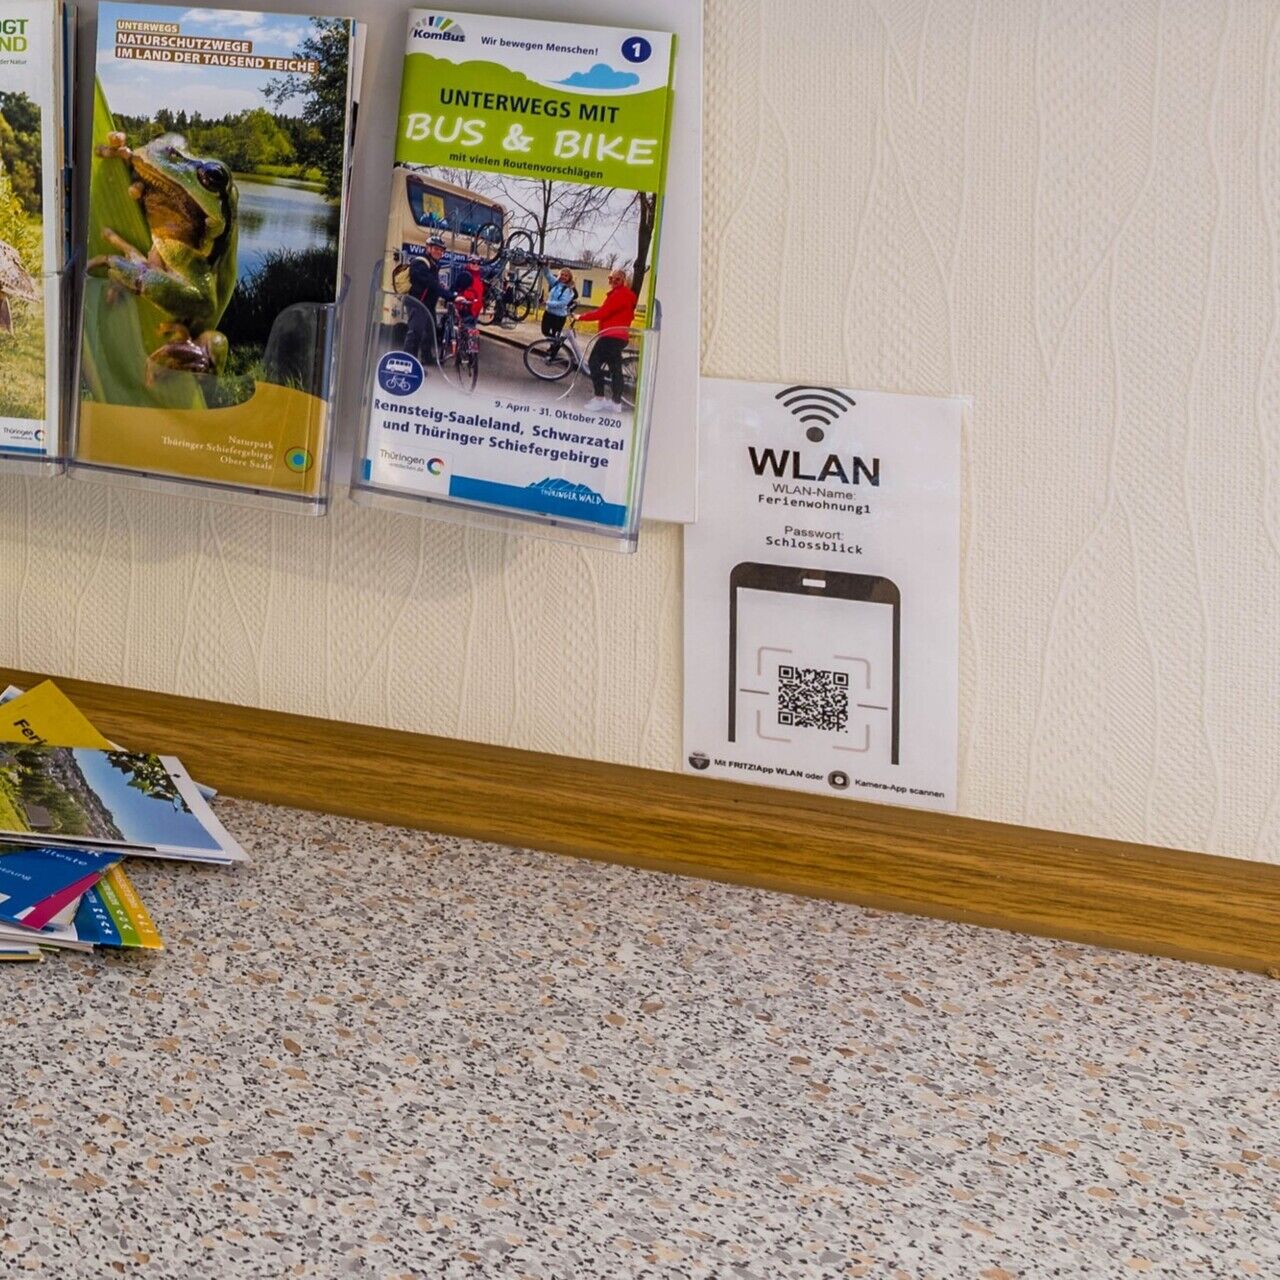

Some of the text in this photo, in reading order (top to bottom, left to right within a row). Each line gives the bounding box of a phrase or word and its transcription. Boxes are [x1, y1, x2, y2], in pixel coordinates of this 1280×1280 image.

[118, 21, 178, 33] UNTERWEGS
[118, 34, 249, 53] NATURSCHUTZWEGE
[414, 29, 598, 56] KomBus Wir bewegen Menschen!
[631, 42, 641, 57] 1
[117, 47, 315, 72] IM LAND DER TAUSEND TEICHE
[440, 88, 620, 124] UNTERWEGS MIT
[405, 112, 658, 165] BUS & BIKE
[449, 152, 603, 180] mit vielen Routenvorschlägen
[374, 399, 625, 451] Rennsteig-Saaleland, Schwarzatal
[382, 420, 610, 468] und Thüringer Schiefergebirge
[748, 446, 880, 487] WLAN
[758, 494, 872, 515] Ferienwohnung1
[772, 483, 856, 500] WLAN-Name:
[765, 536, 863, 555] Schlossblick
[784, 525, 844, 540] Passwort:
[714, 759, 727, 768] Mit
[776, 768, 803, 777] WLAN
[805, 772, 824, 781] oder
[855, 778, 907, 793] Kamera-App
[910, 787, 945, 798] scannen
